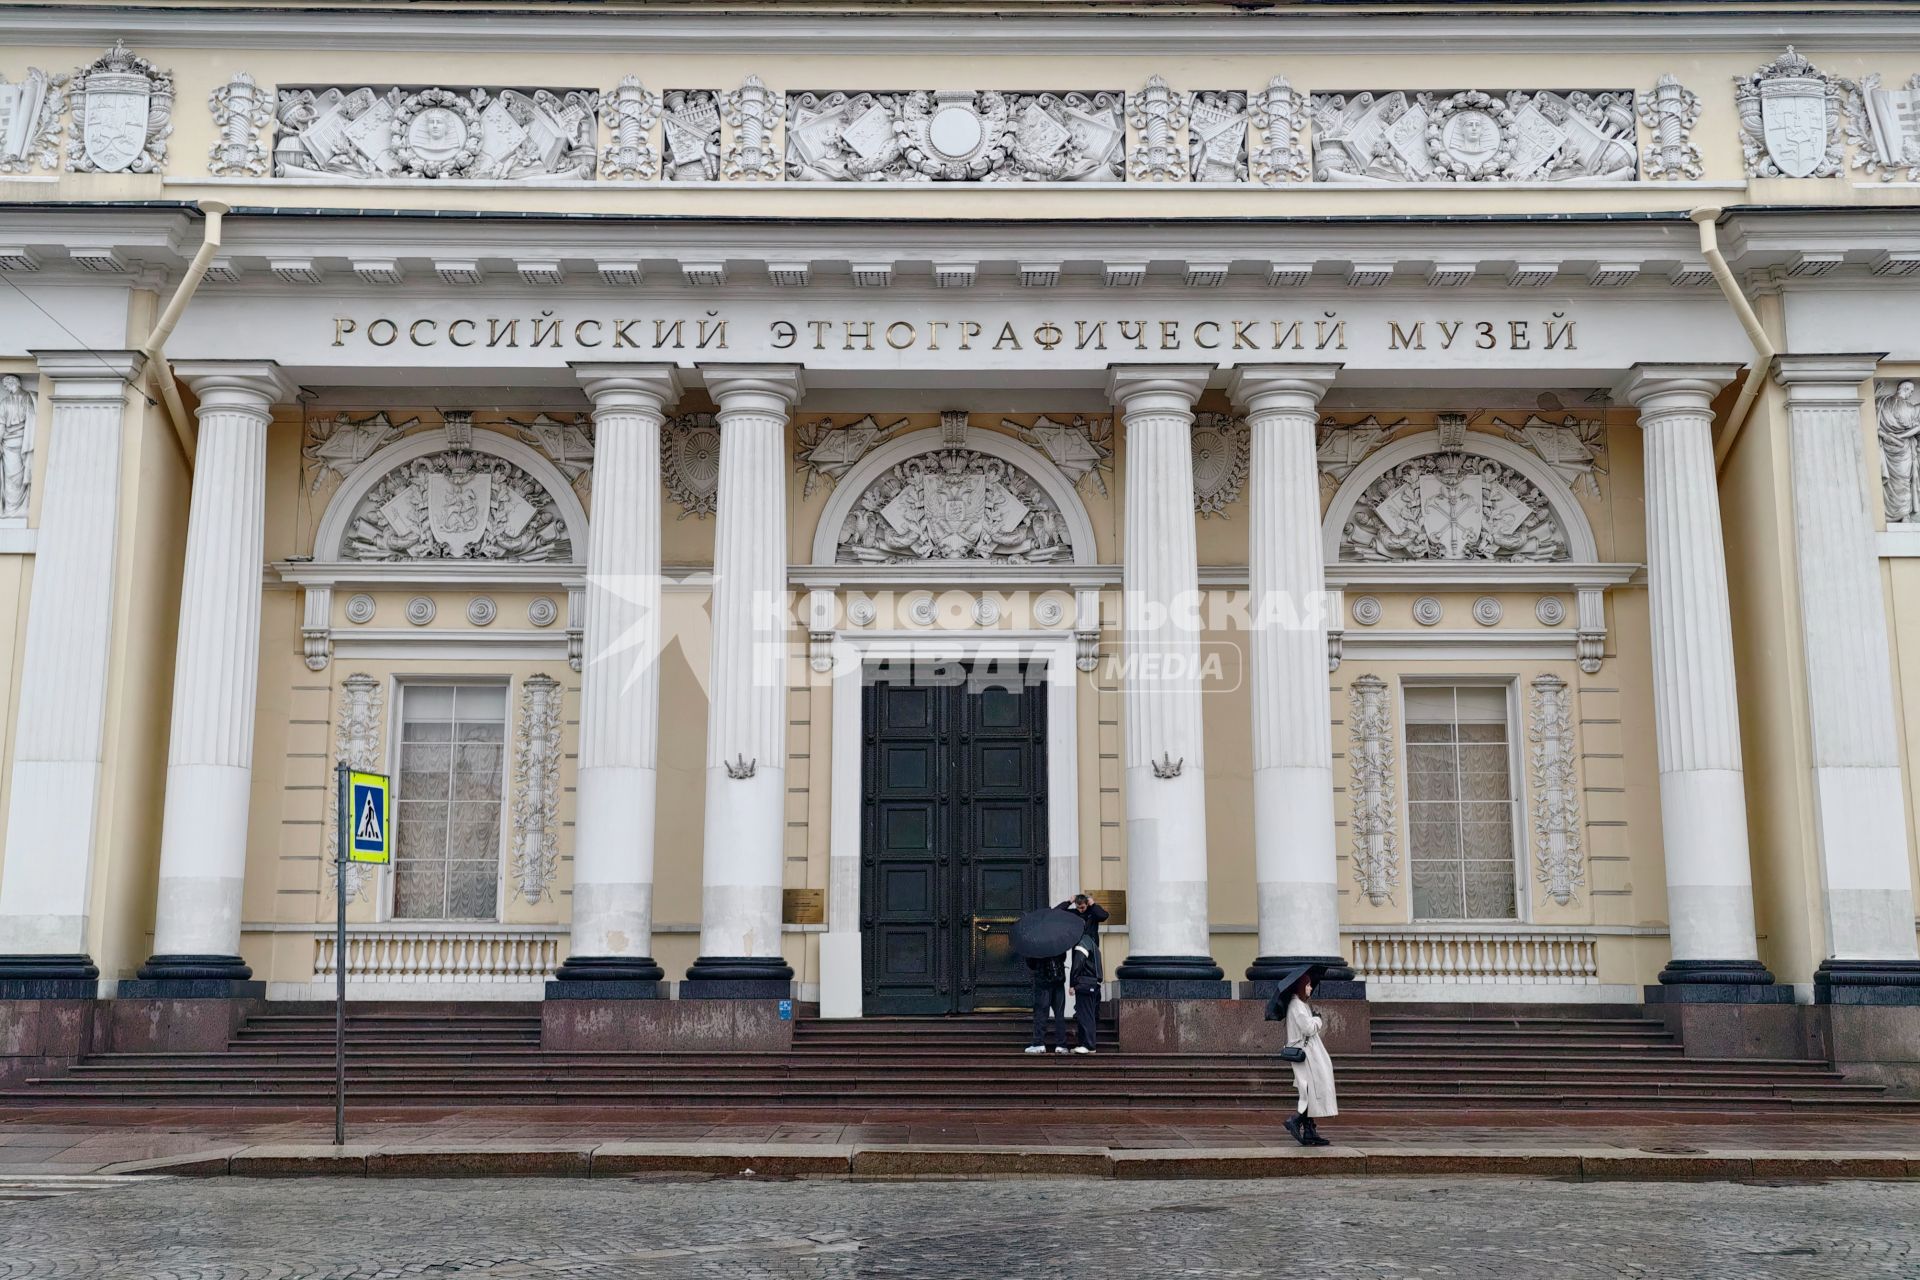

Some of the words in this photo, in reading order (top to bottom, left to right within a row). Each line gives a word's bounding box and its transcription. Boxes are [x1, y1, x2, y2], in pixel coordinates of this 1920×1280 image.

[332, 309, 730, 349] РОССИЙСКИЙ
[770, 311, 1348, 351] ЭТНОГРАФИЧЕСКИЙ
[1388, 311, 1577, 350] МУЗЕЙ
